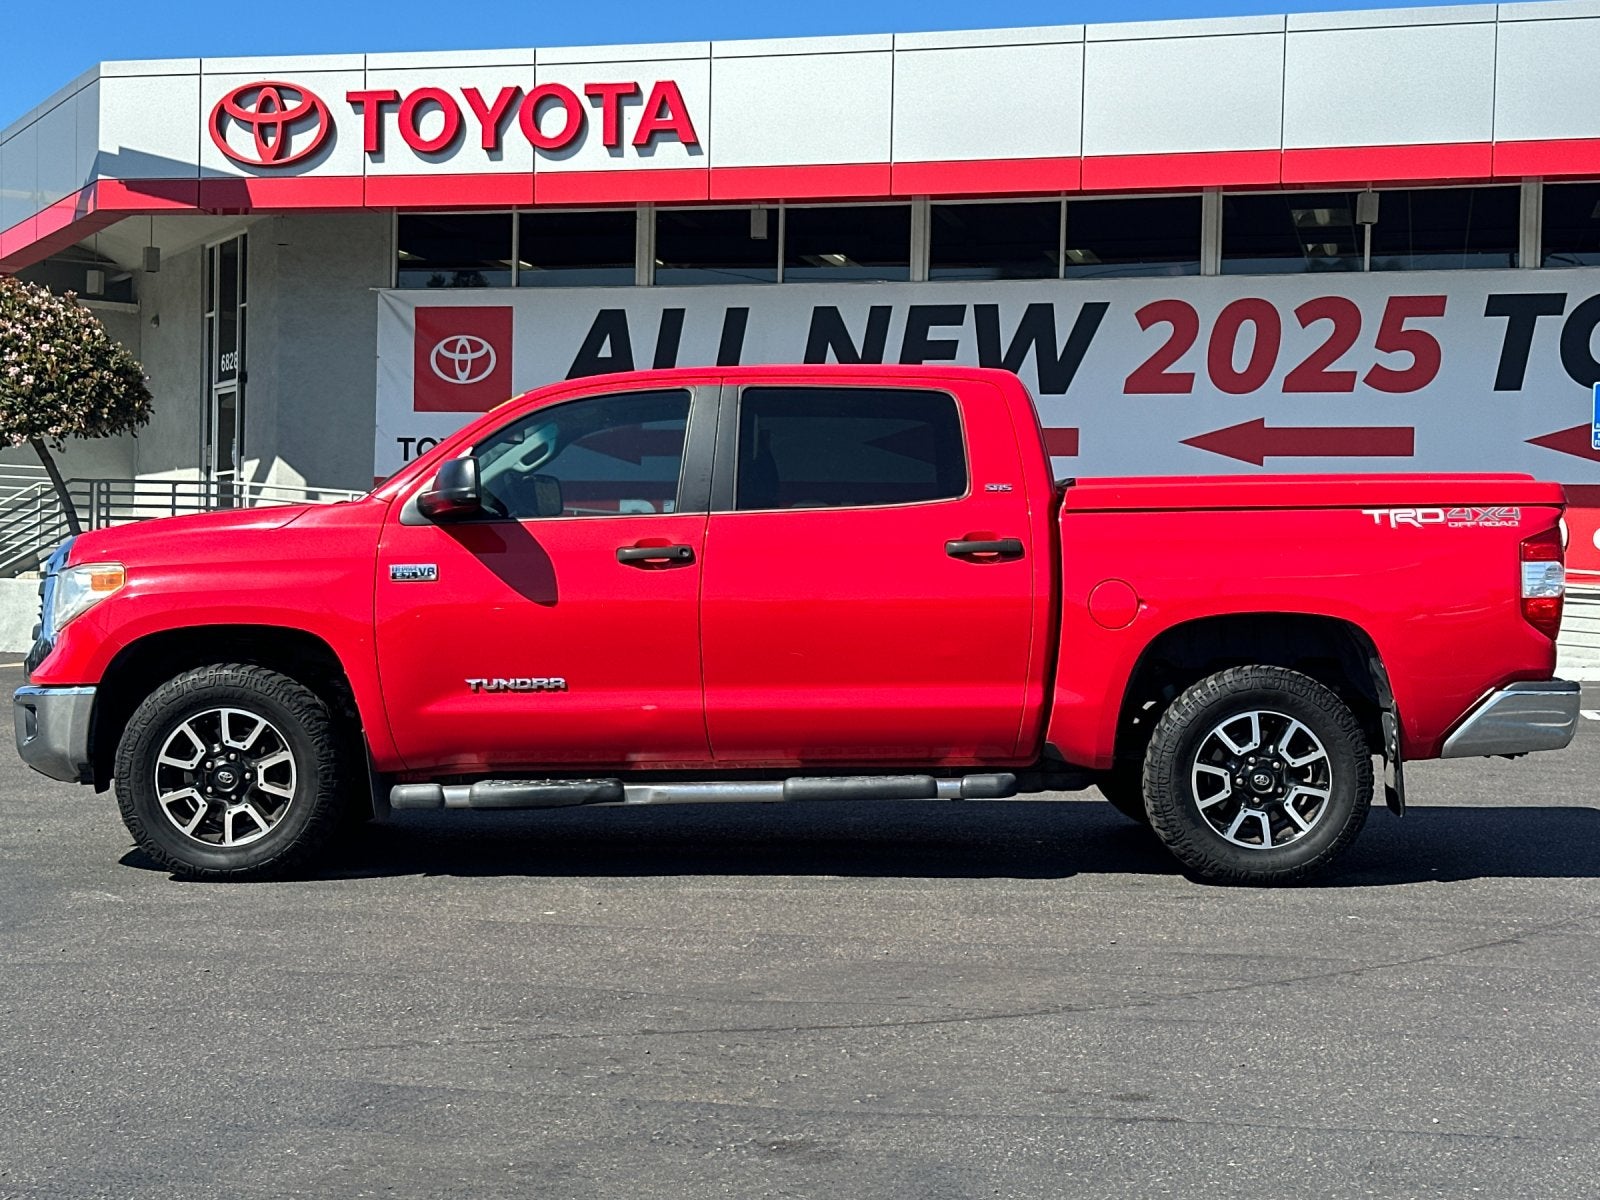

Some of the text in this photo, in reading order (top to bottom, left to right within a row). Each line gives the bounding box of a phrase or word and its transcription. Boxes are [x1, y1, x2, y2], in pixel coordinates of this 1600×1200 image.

[346, 80, 699, 153] TOYOTA
[565, 306, 750, 380] ALL
[803, 302, 1111, 395] NEW
[1123, 295, 1448, 395] 2025
[397, 436, 447, 461] TO
[1362, 507, 1446, 529] TRD
[1448, 520, 1519, 528] OFF ROAD
[464, 677, 567, 691] TUNDRA
